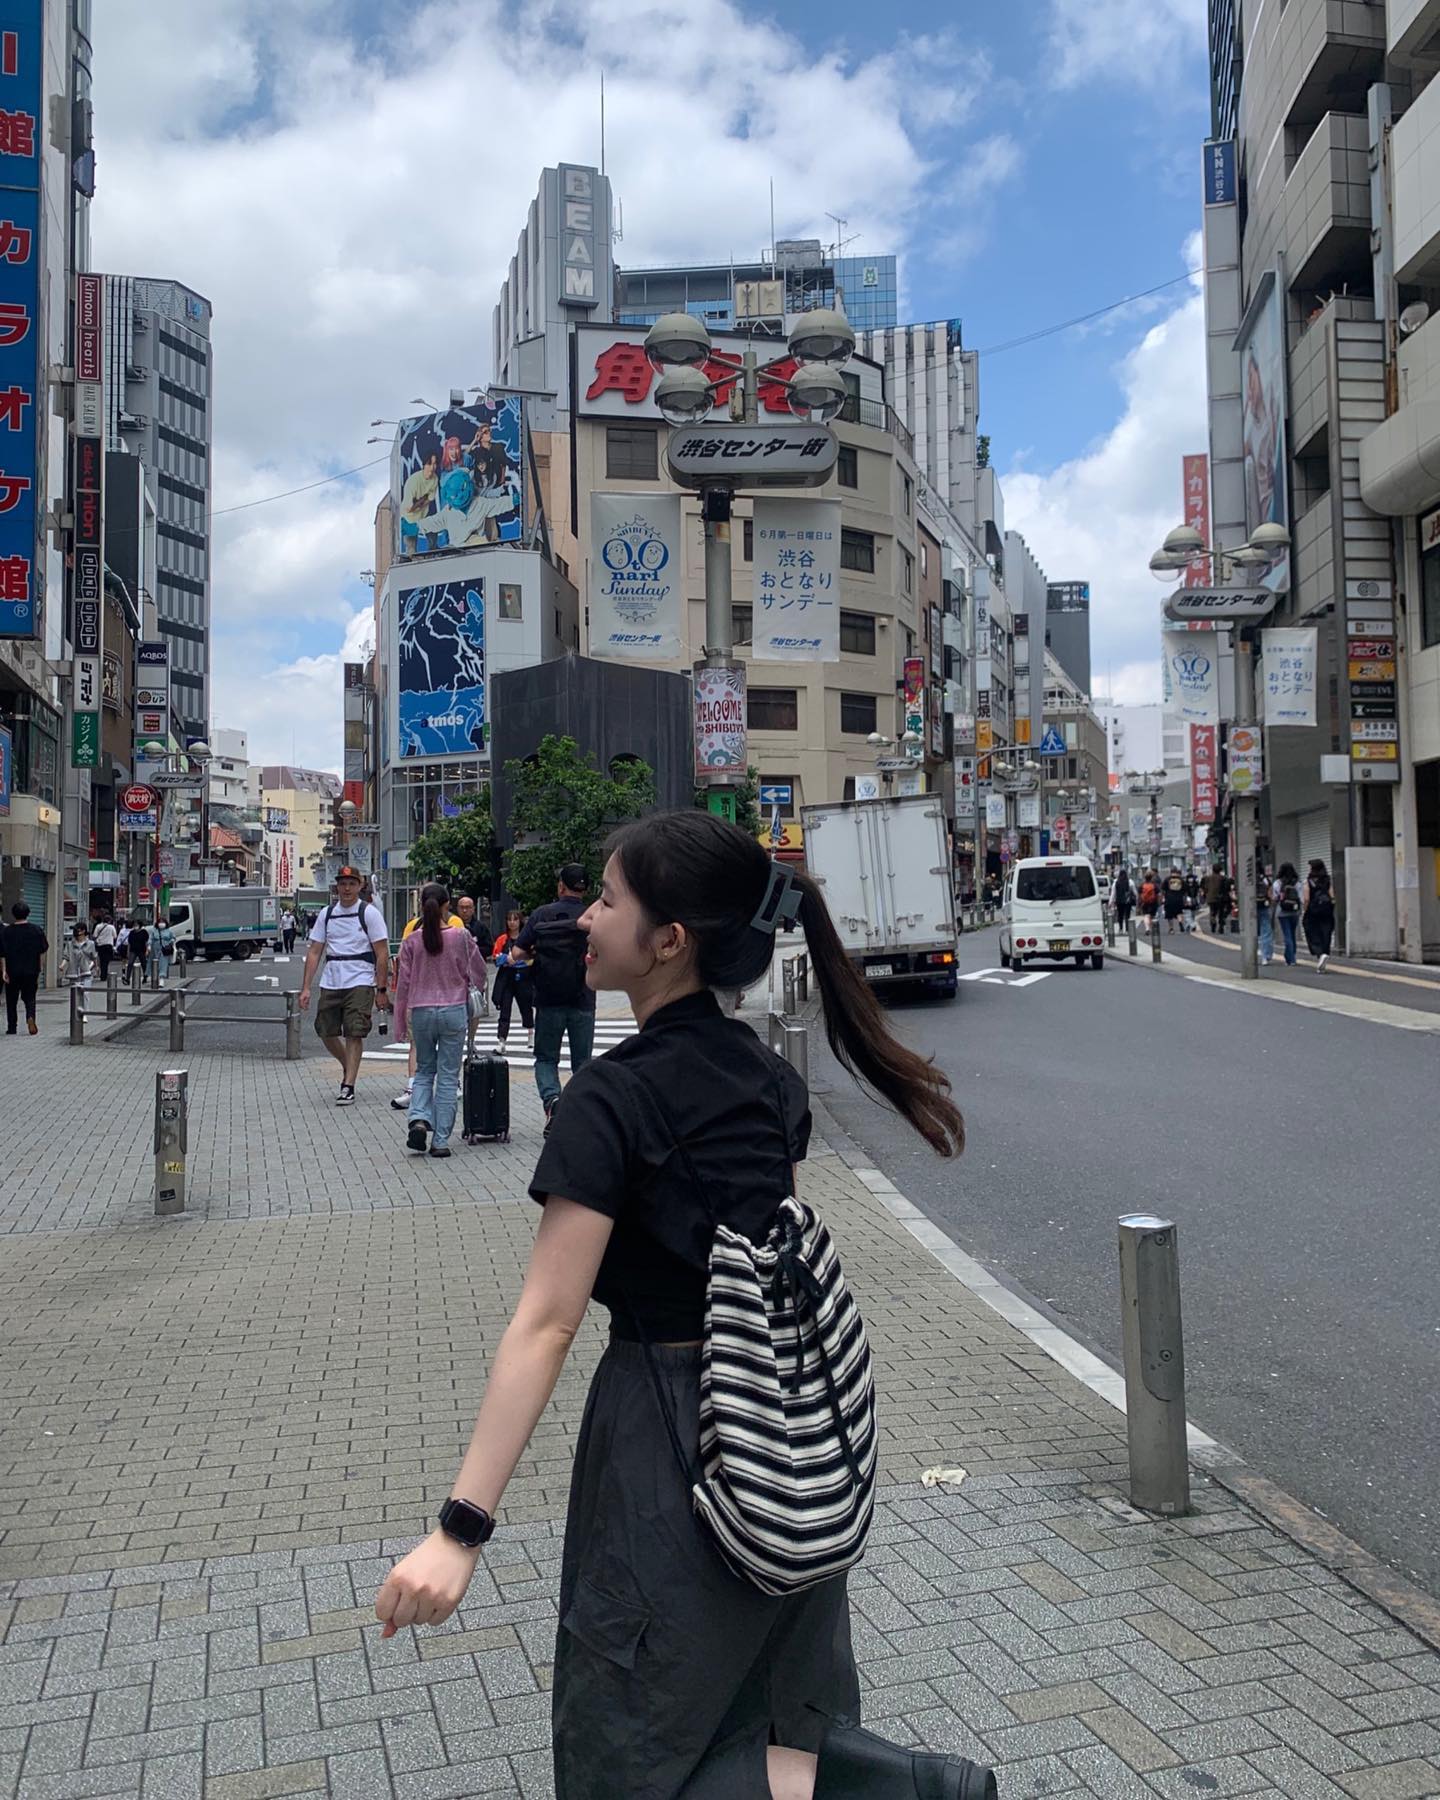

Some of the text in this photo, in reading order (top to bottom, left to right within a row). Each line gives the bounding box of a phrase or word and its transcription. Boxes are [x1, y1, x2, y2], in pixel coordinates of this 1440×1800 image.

[565, 169, 594, 297] BEAM
[84, 280, 96, 375] kimono hearts
[0, 219, 32, 603] カラオケ館
[677, 438, 828, 459] 渋谷センター街
[83, 444, 94, 538] disk union
[759, 529, 833, 540] 6月第一日曜日は
[778, 548, 815, 569] 渋谷
[611, 570, 660, 581] nari
[759, 571, 832, 589] おとなり
[600, 581, 671, 600] Sunday
[759, 592, 833, 611] サンデー
[1178, 594, 1269, 607] 渋谷センター街
[608, 634, 663, 642] 渋谷センター街
[769, 638, 823, 647] 渋谷センター街
[1268, 671, 1313, 682] おとなり
[1268, 684, 1313, 695] サンデー
[696, 699, 742, 722] WELCOME
[81, 715, 90, 743] カジノ
[420, 714, 465, 728] atmos
